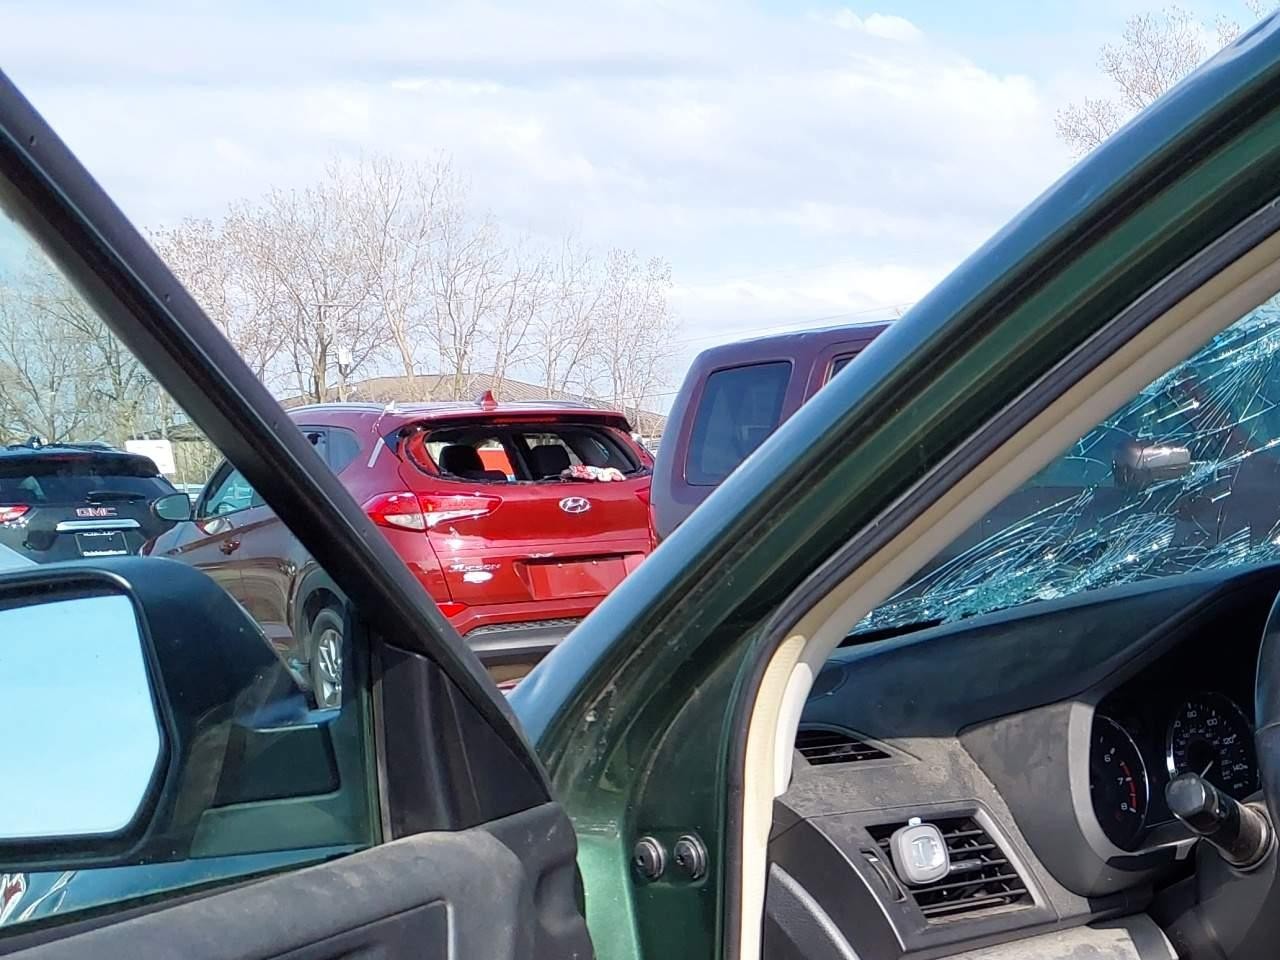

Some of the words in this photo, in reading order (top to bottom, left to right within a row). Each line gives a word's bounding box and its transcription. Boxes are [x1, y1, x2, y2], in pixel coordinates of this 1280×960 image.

[76, 507, 118, 517] GMC
[1104, 754, 1111, 763] 6
[1117, 777, 1124, 785] 7
[1120, 802, 1128, 811] 8
